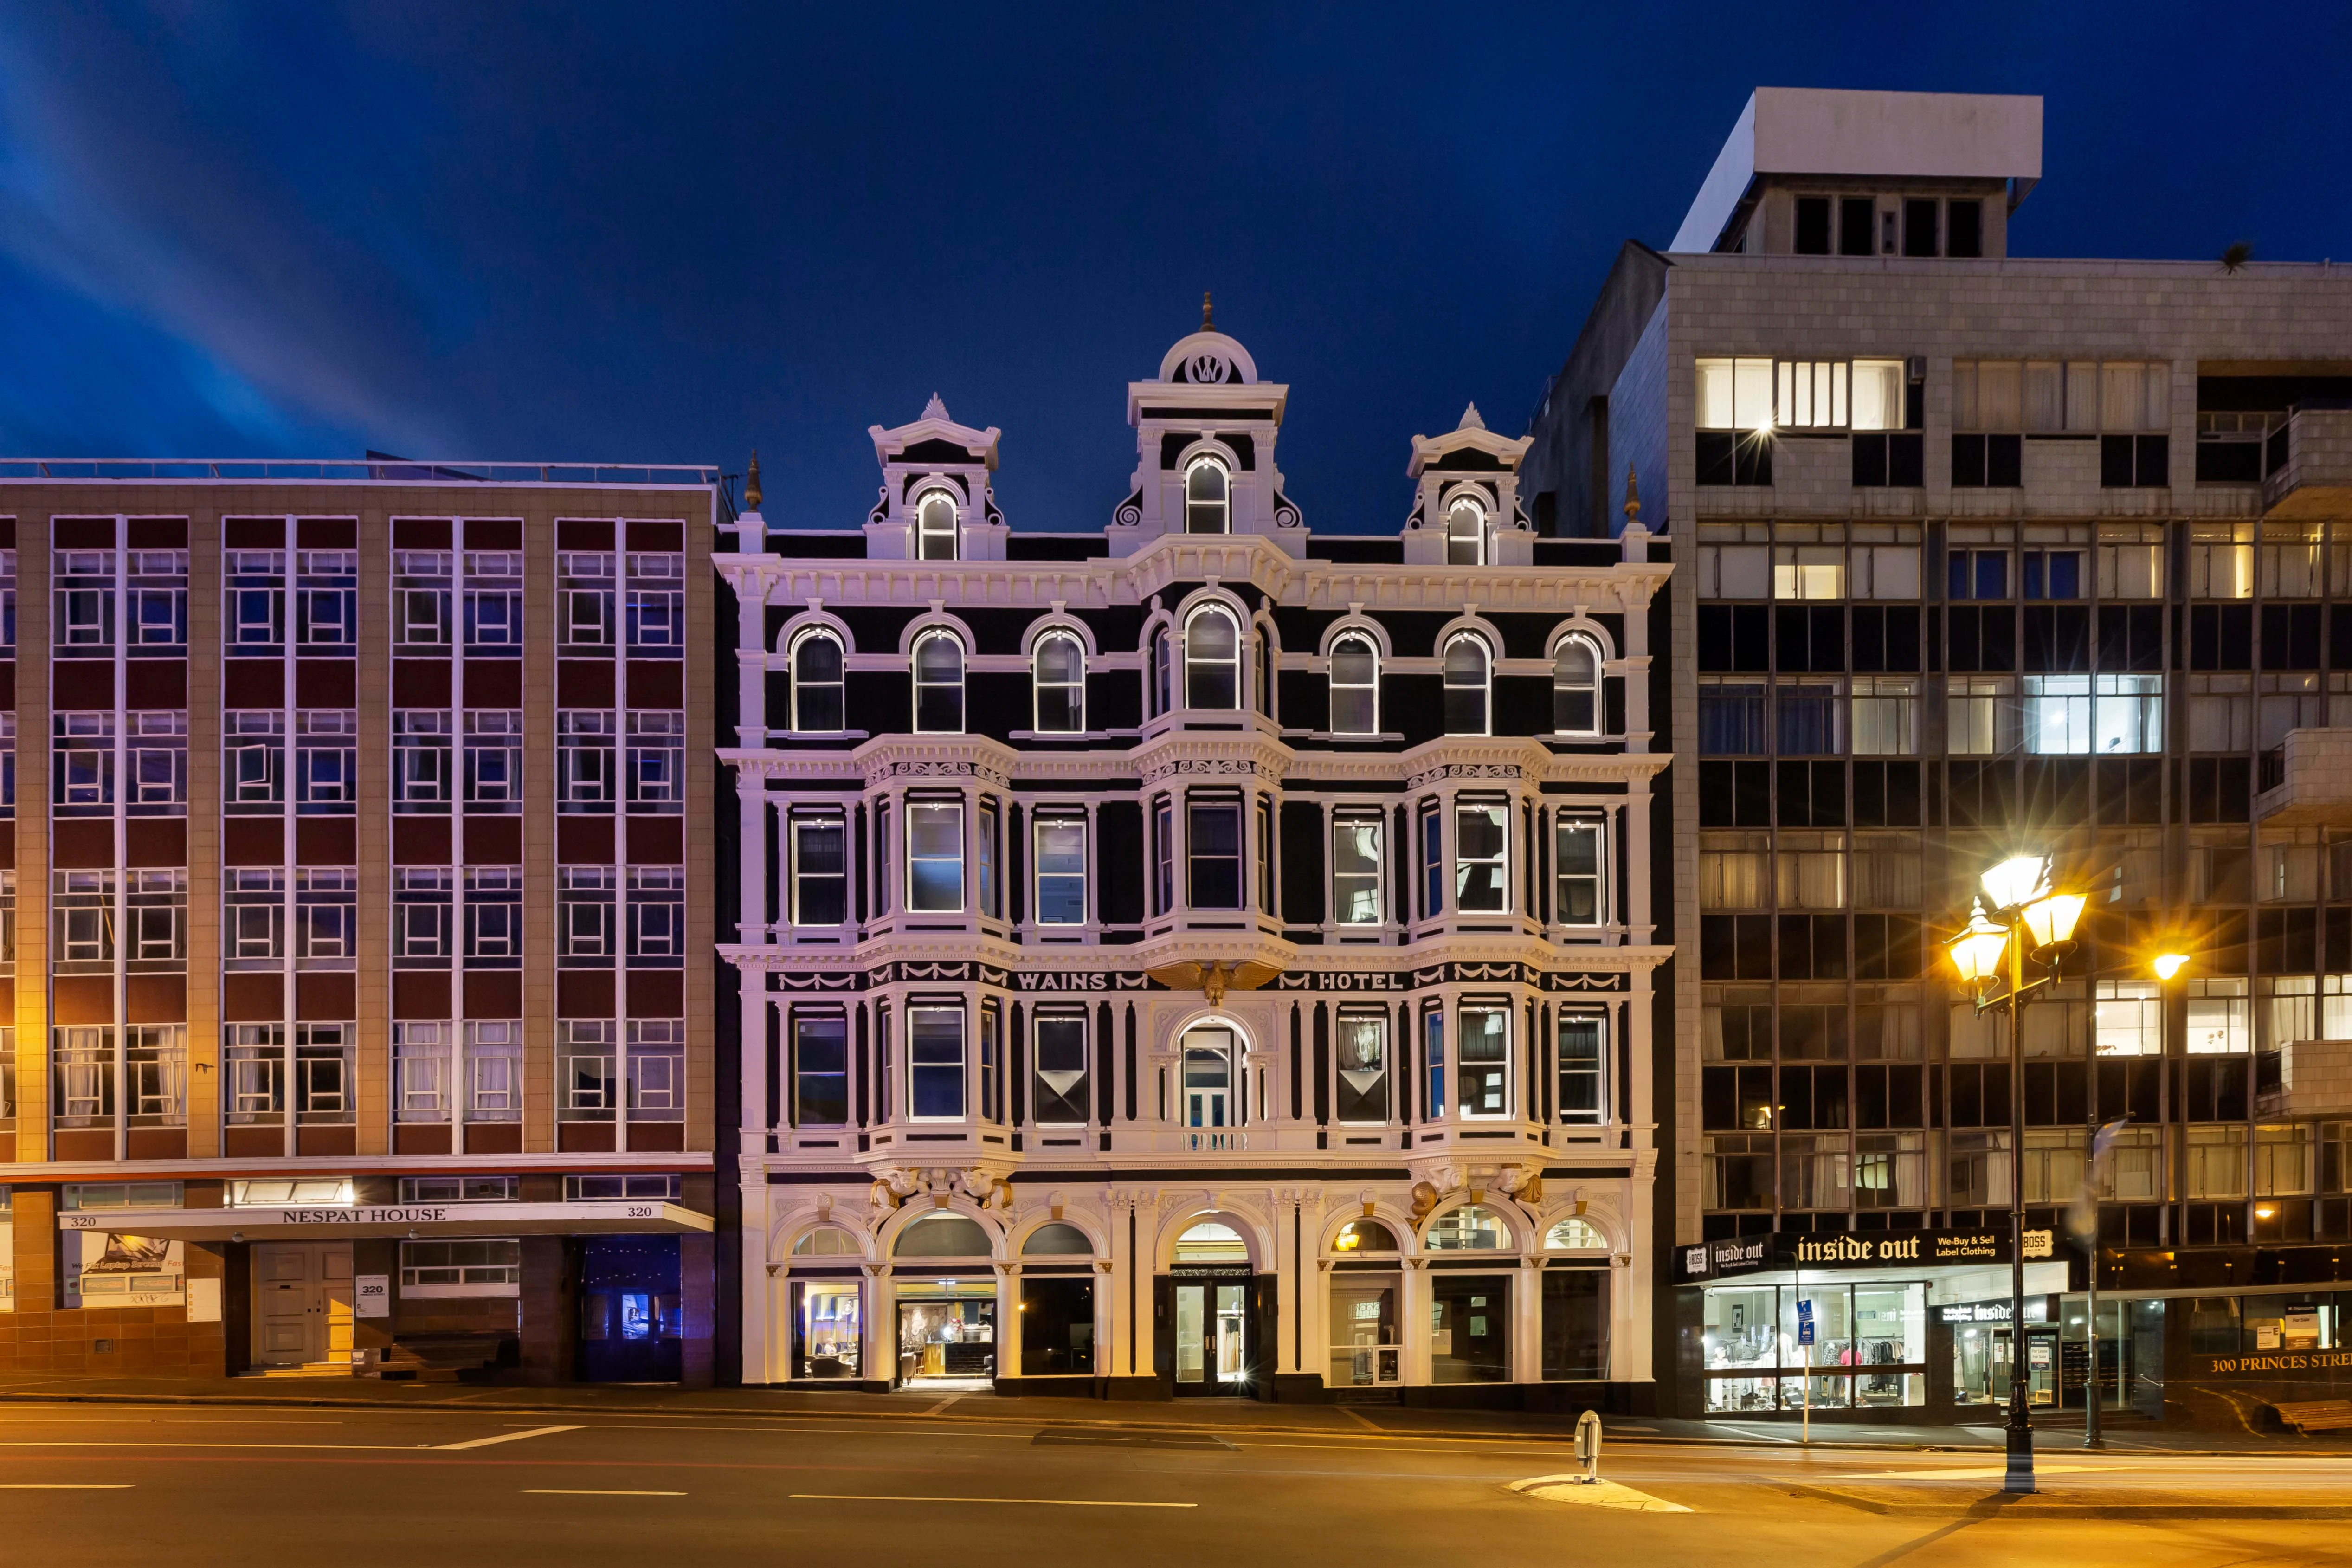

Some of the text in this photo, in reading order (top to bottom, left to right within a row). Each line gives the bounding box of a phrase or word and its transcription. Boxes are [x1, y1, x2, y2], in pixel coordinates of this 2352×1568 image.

[1018, 974, 1403, 989] WAINS HOTEL
[283, 1209, 446, 1223] NESPAT HOUSE
[628, 1207, 651, 1217] 320
[71, 1217, 96, 1227] 320
[1954, 1237, 1969, 1246] Buy
[2023, 1236, 2045, 1247] BOSS
[1716, 1242, 1763, 1262] inside out
[1798, 1235, 1920, 1261] inside out
[1936, 1247, 1995, 1256] Label Clothing
[1692, 1253, 1702, 1265] BOSS
[100, 1261, 131, 1270] Laptop
[1974, 1304, 2012, 1321] inside
[2210, 1353, 2352, 1372] 300 PRINCES STRE
